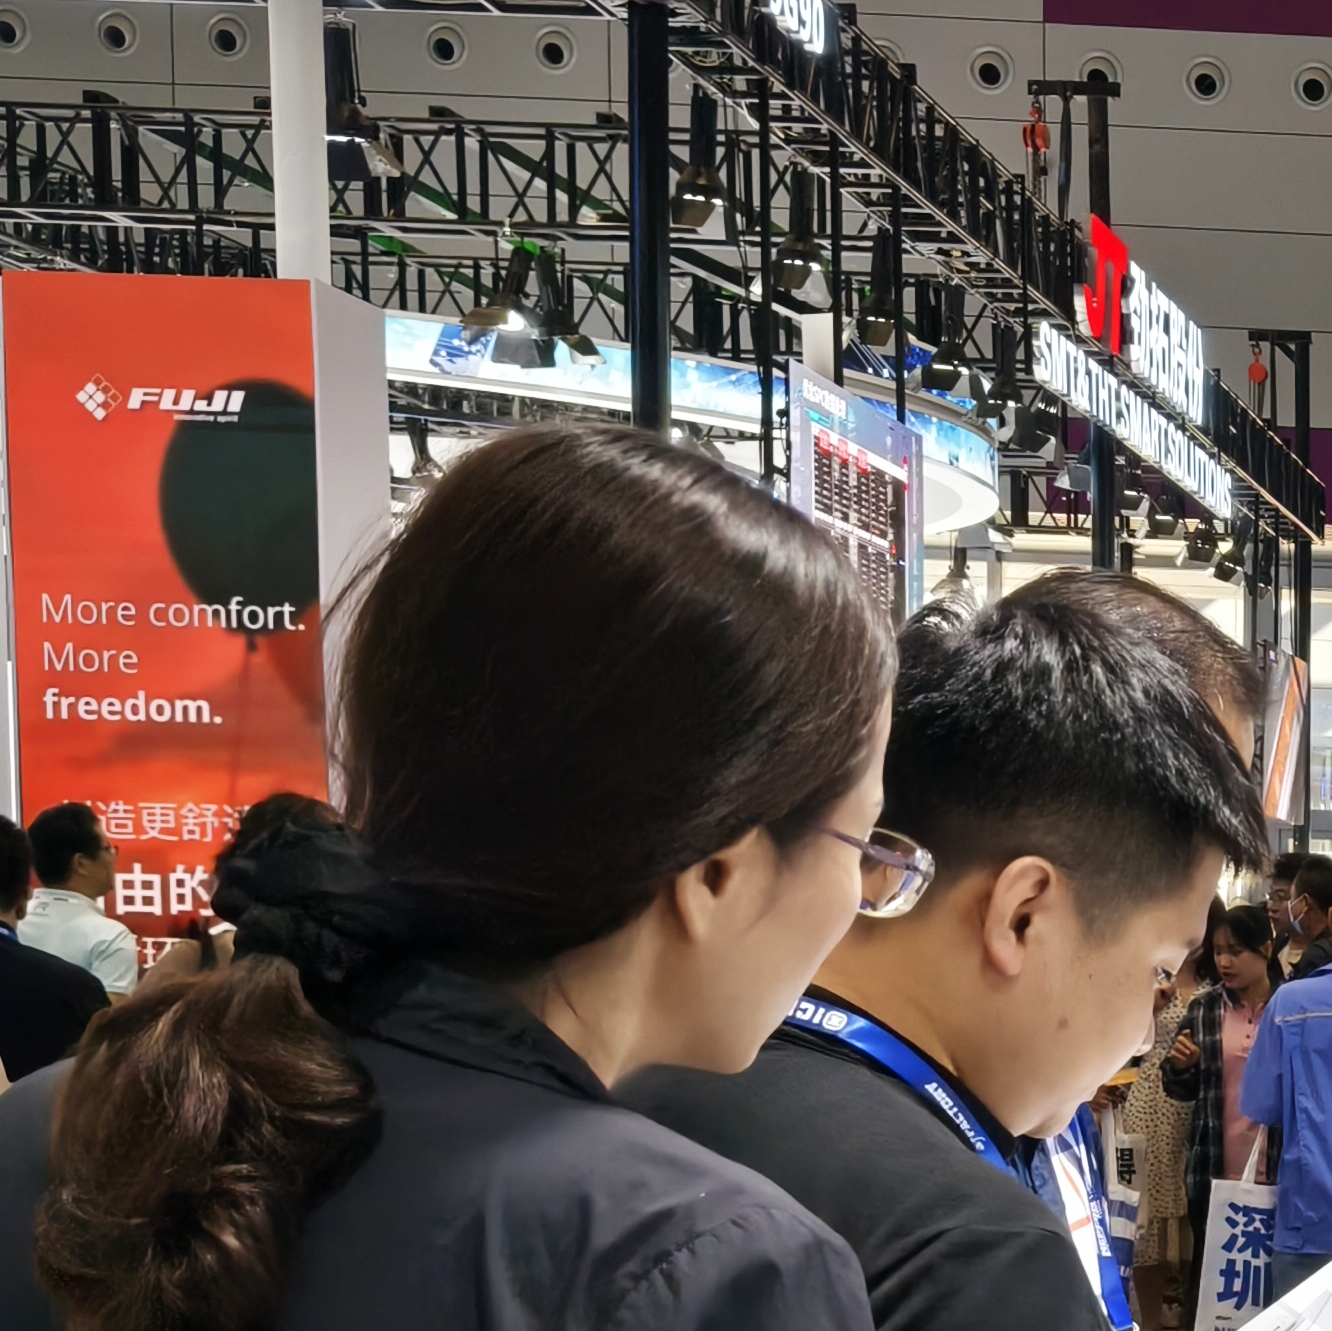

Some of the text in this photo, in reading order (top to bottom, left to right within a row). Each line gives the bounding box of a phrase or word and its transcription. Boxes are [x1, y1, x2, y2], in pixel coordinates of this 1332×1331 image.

[127, 387, 246, 413] FUJI
[1120, 384, 1167, 467] SMART
[1167, 422, 1232, 518] SOLUTIONS
[41, 592, 306, 632] More comfort.
[42, 641, 139, 674] More
[43, 687, 224, 724] freedom.
[1217, 1201, 1276, 1312] 深圳
